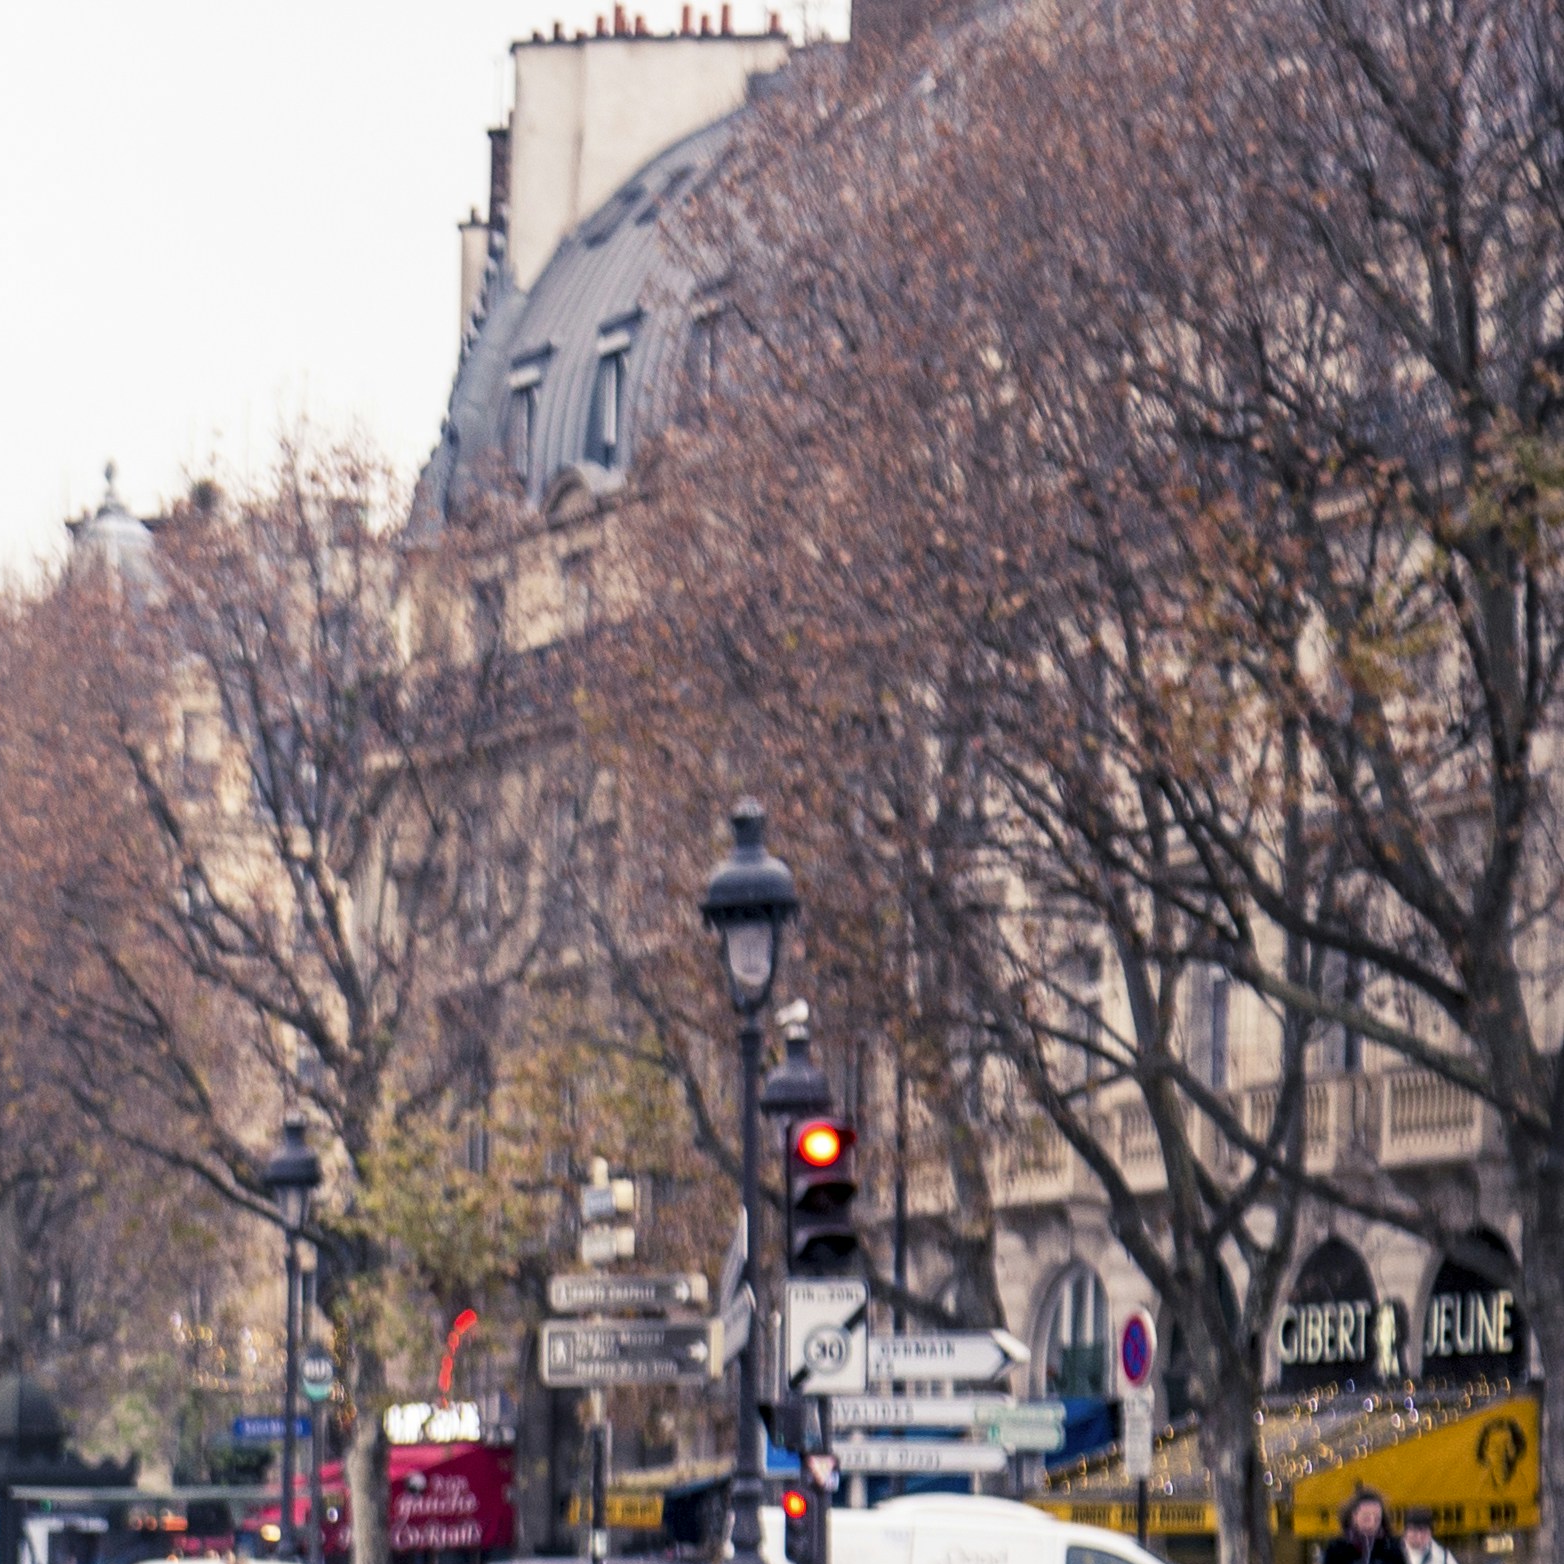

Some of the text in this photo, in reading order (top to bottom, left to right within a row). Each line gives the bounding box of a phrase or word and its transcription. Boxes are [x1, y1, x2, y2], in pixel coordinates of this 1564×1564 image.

[815, 1338, 844, 1361] 30
[1278, 1289, 1514, 1364] GIBERT JEUNE
